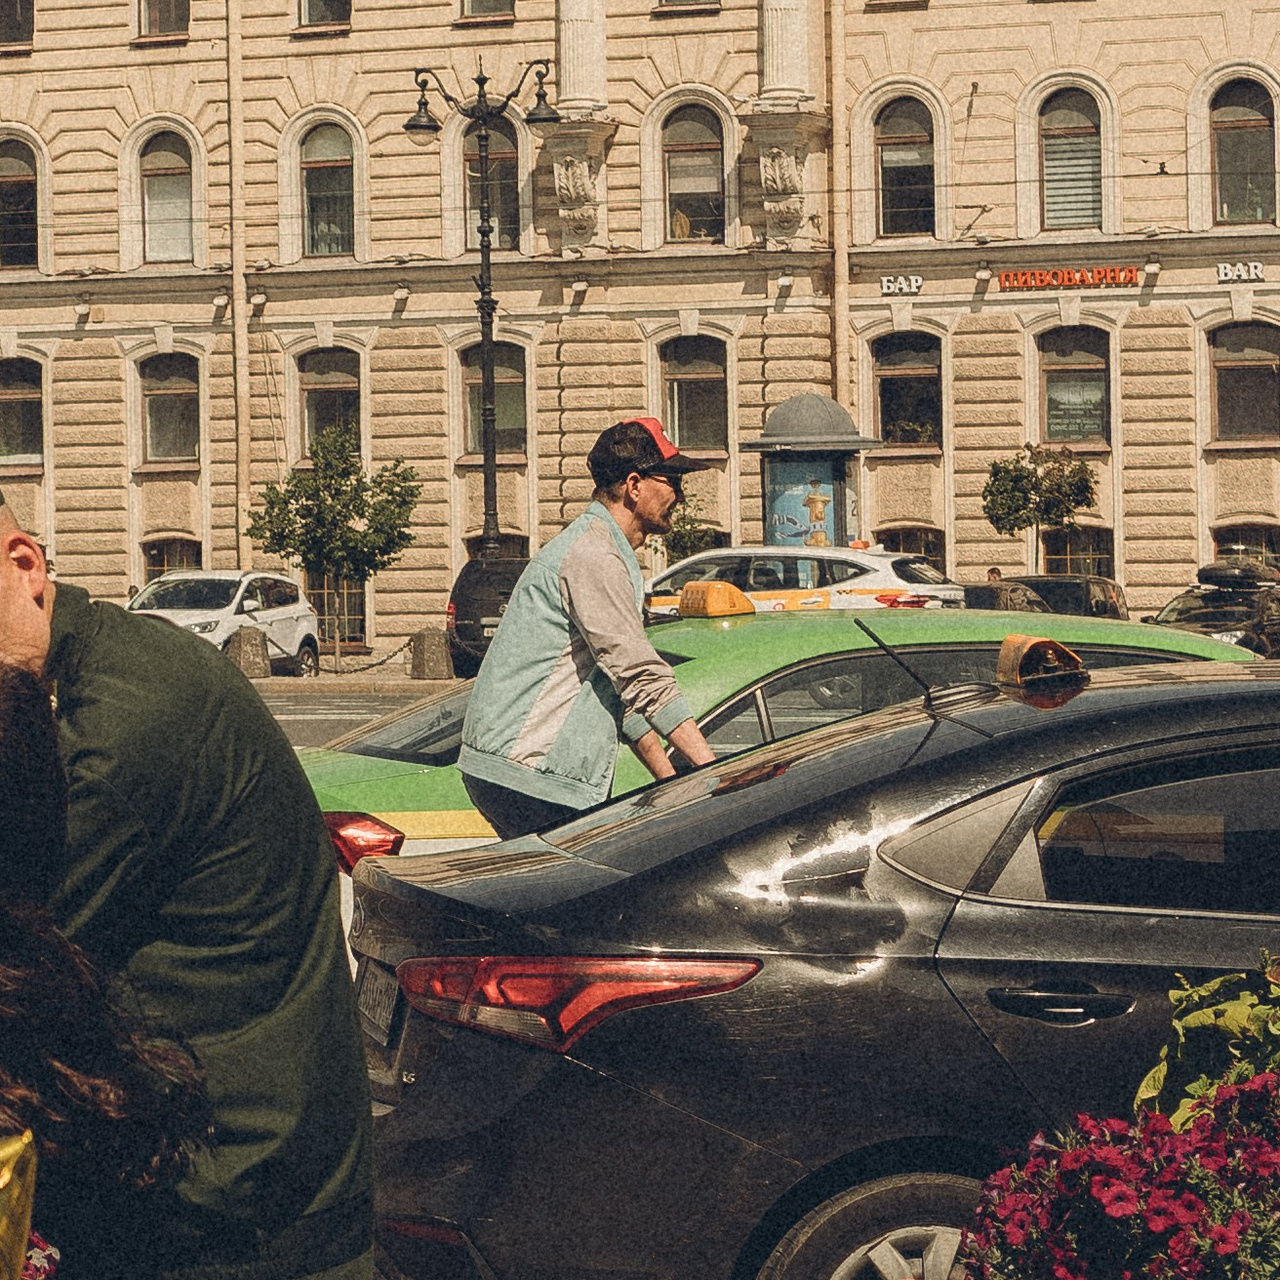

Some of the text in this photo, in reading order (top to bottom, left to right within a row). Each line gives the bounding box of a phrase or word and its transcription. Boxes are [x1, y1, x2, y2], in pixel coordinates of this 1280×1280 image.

[999, 266, 1139, 289] ПИВОВАРНЯ
[1217, 261, 1264, 281] BAR
[880, 275, 923, 295] БАР
